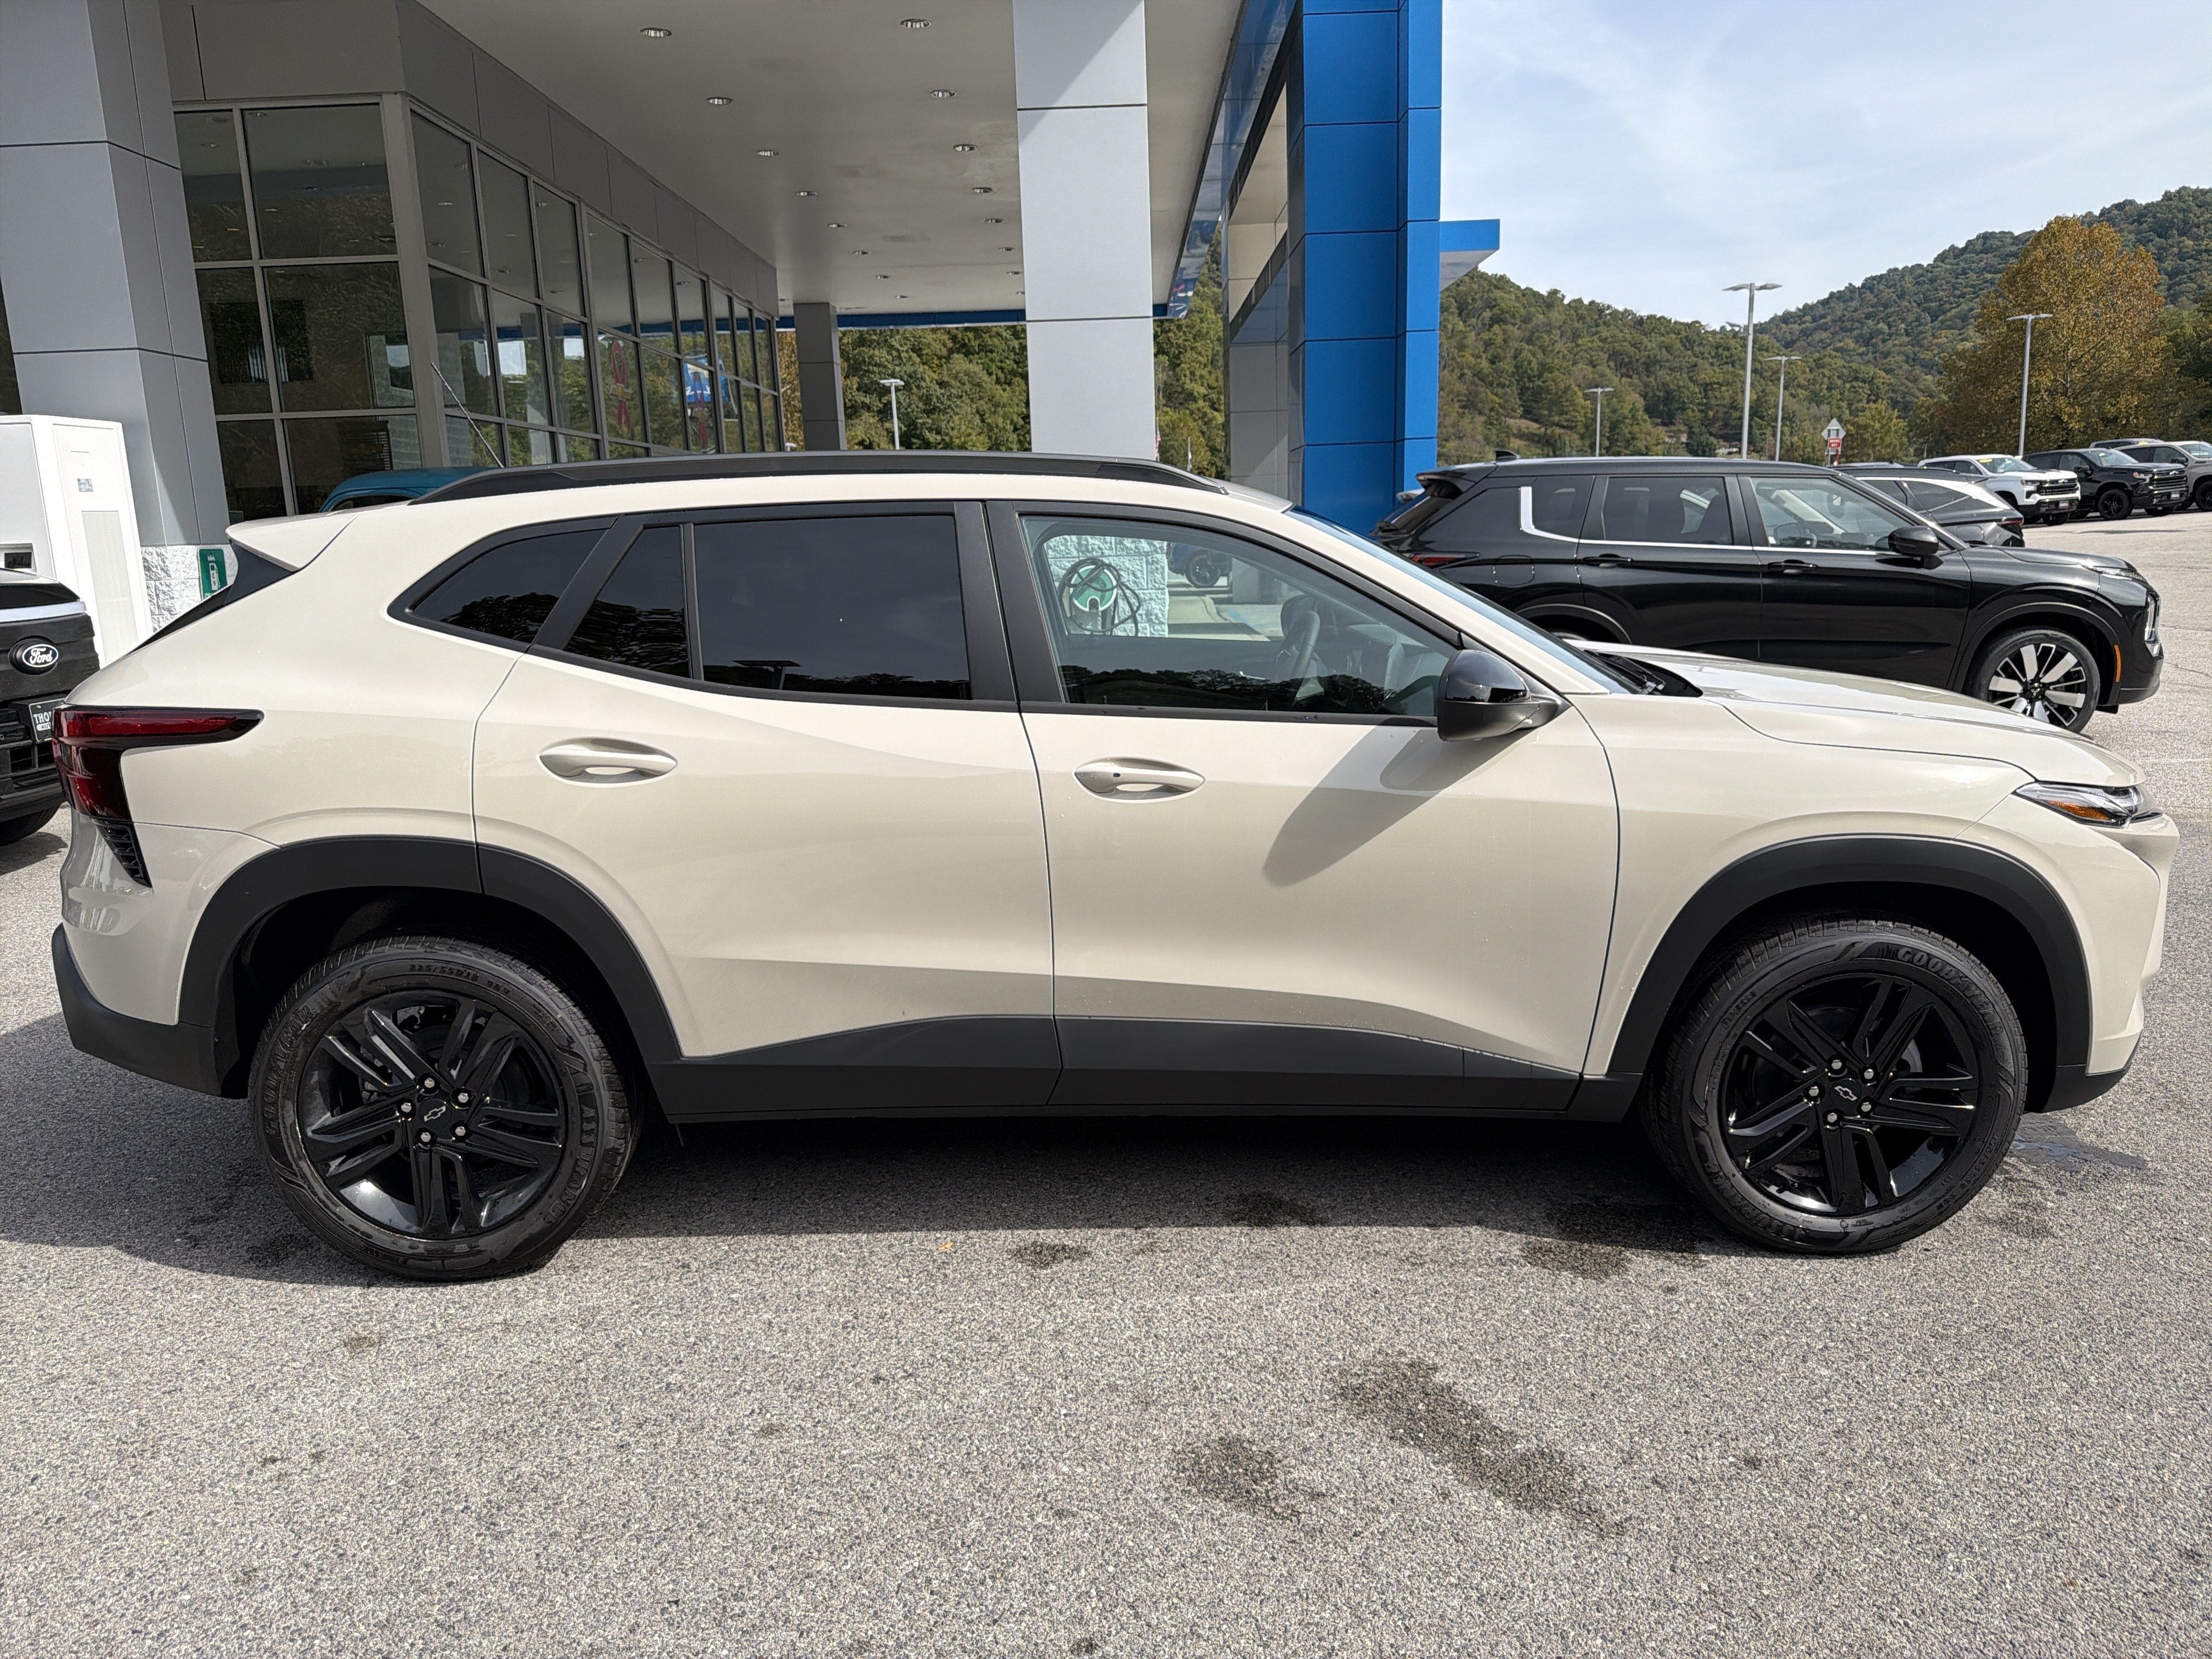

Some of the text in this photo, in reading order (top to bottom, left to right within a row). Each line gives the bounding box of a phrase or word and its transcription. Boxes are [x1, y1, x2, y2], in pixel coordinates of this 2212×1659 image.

[30, 647, 53, 664] Ford
[1897, 947, 2005, 1035] GOODYEAR
[543, 1103, 597, 1224] ASSURANCE
